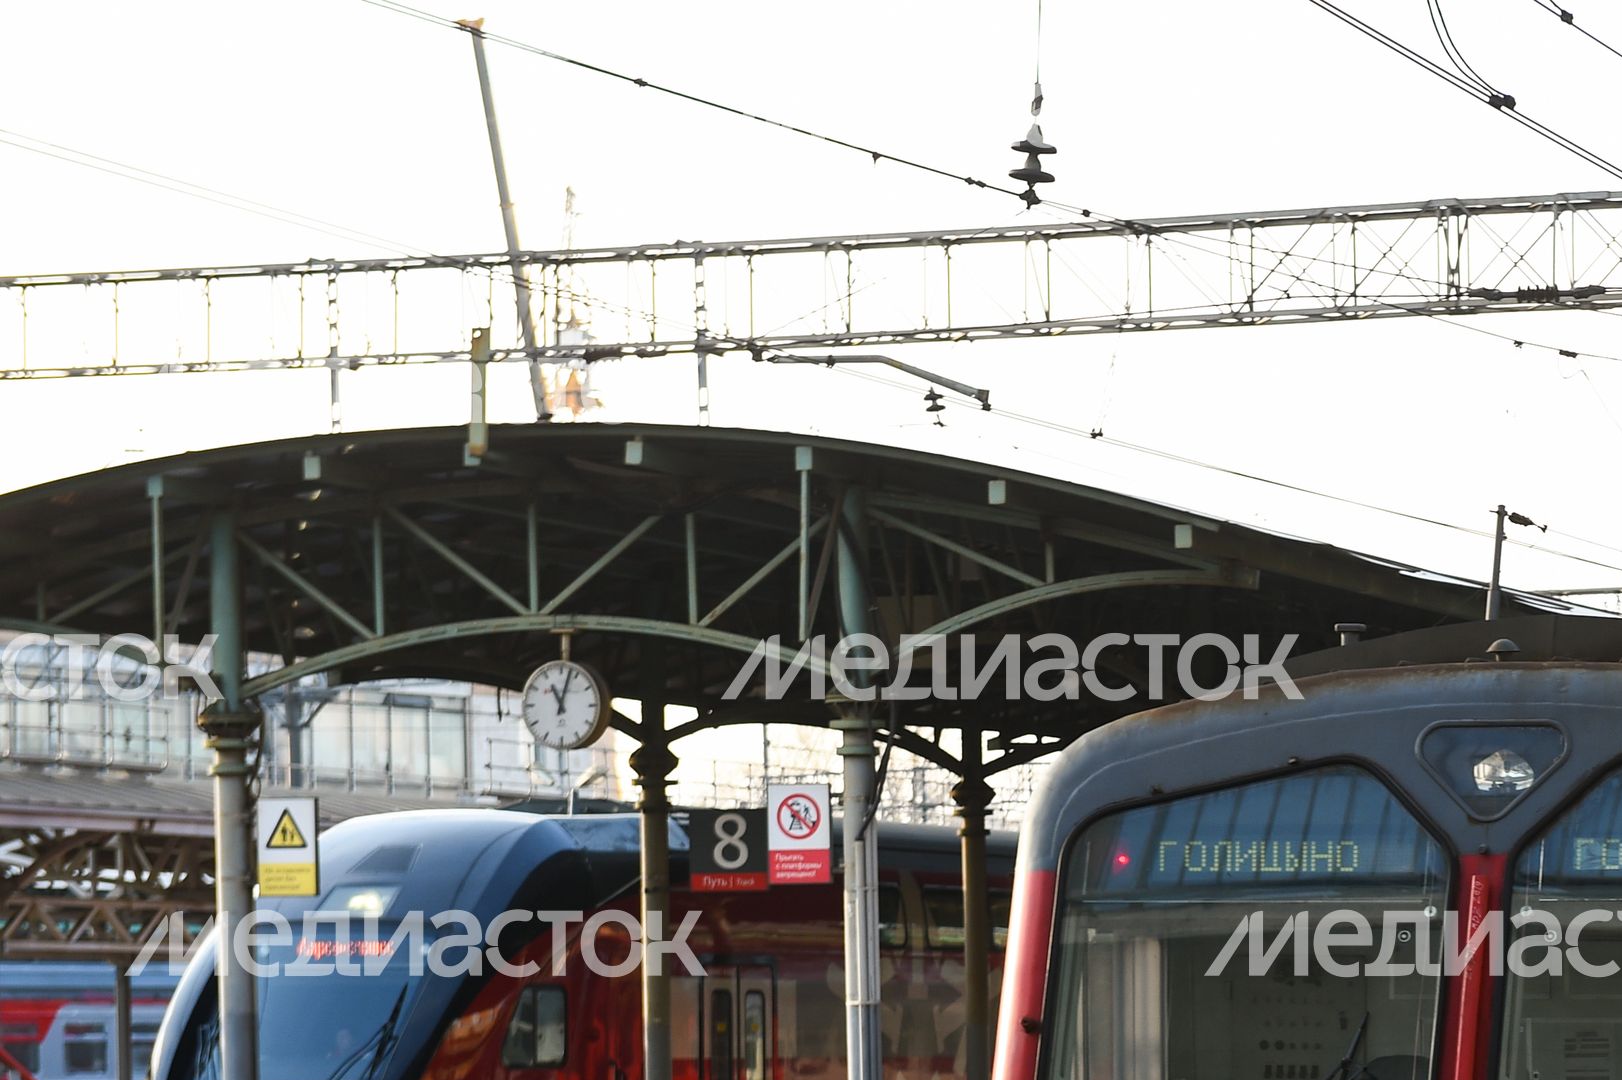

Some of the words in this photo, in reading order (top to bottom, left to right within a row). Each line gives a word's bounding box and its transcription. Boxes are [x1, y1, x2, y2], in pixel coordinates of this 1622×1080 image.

[713, 812, 749, 870] 8
[1159, 841, 1358, 872] ГОЛИЦЫНО
[703, 875, 728, 890] Путь
